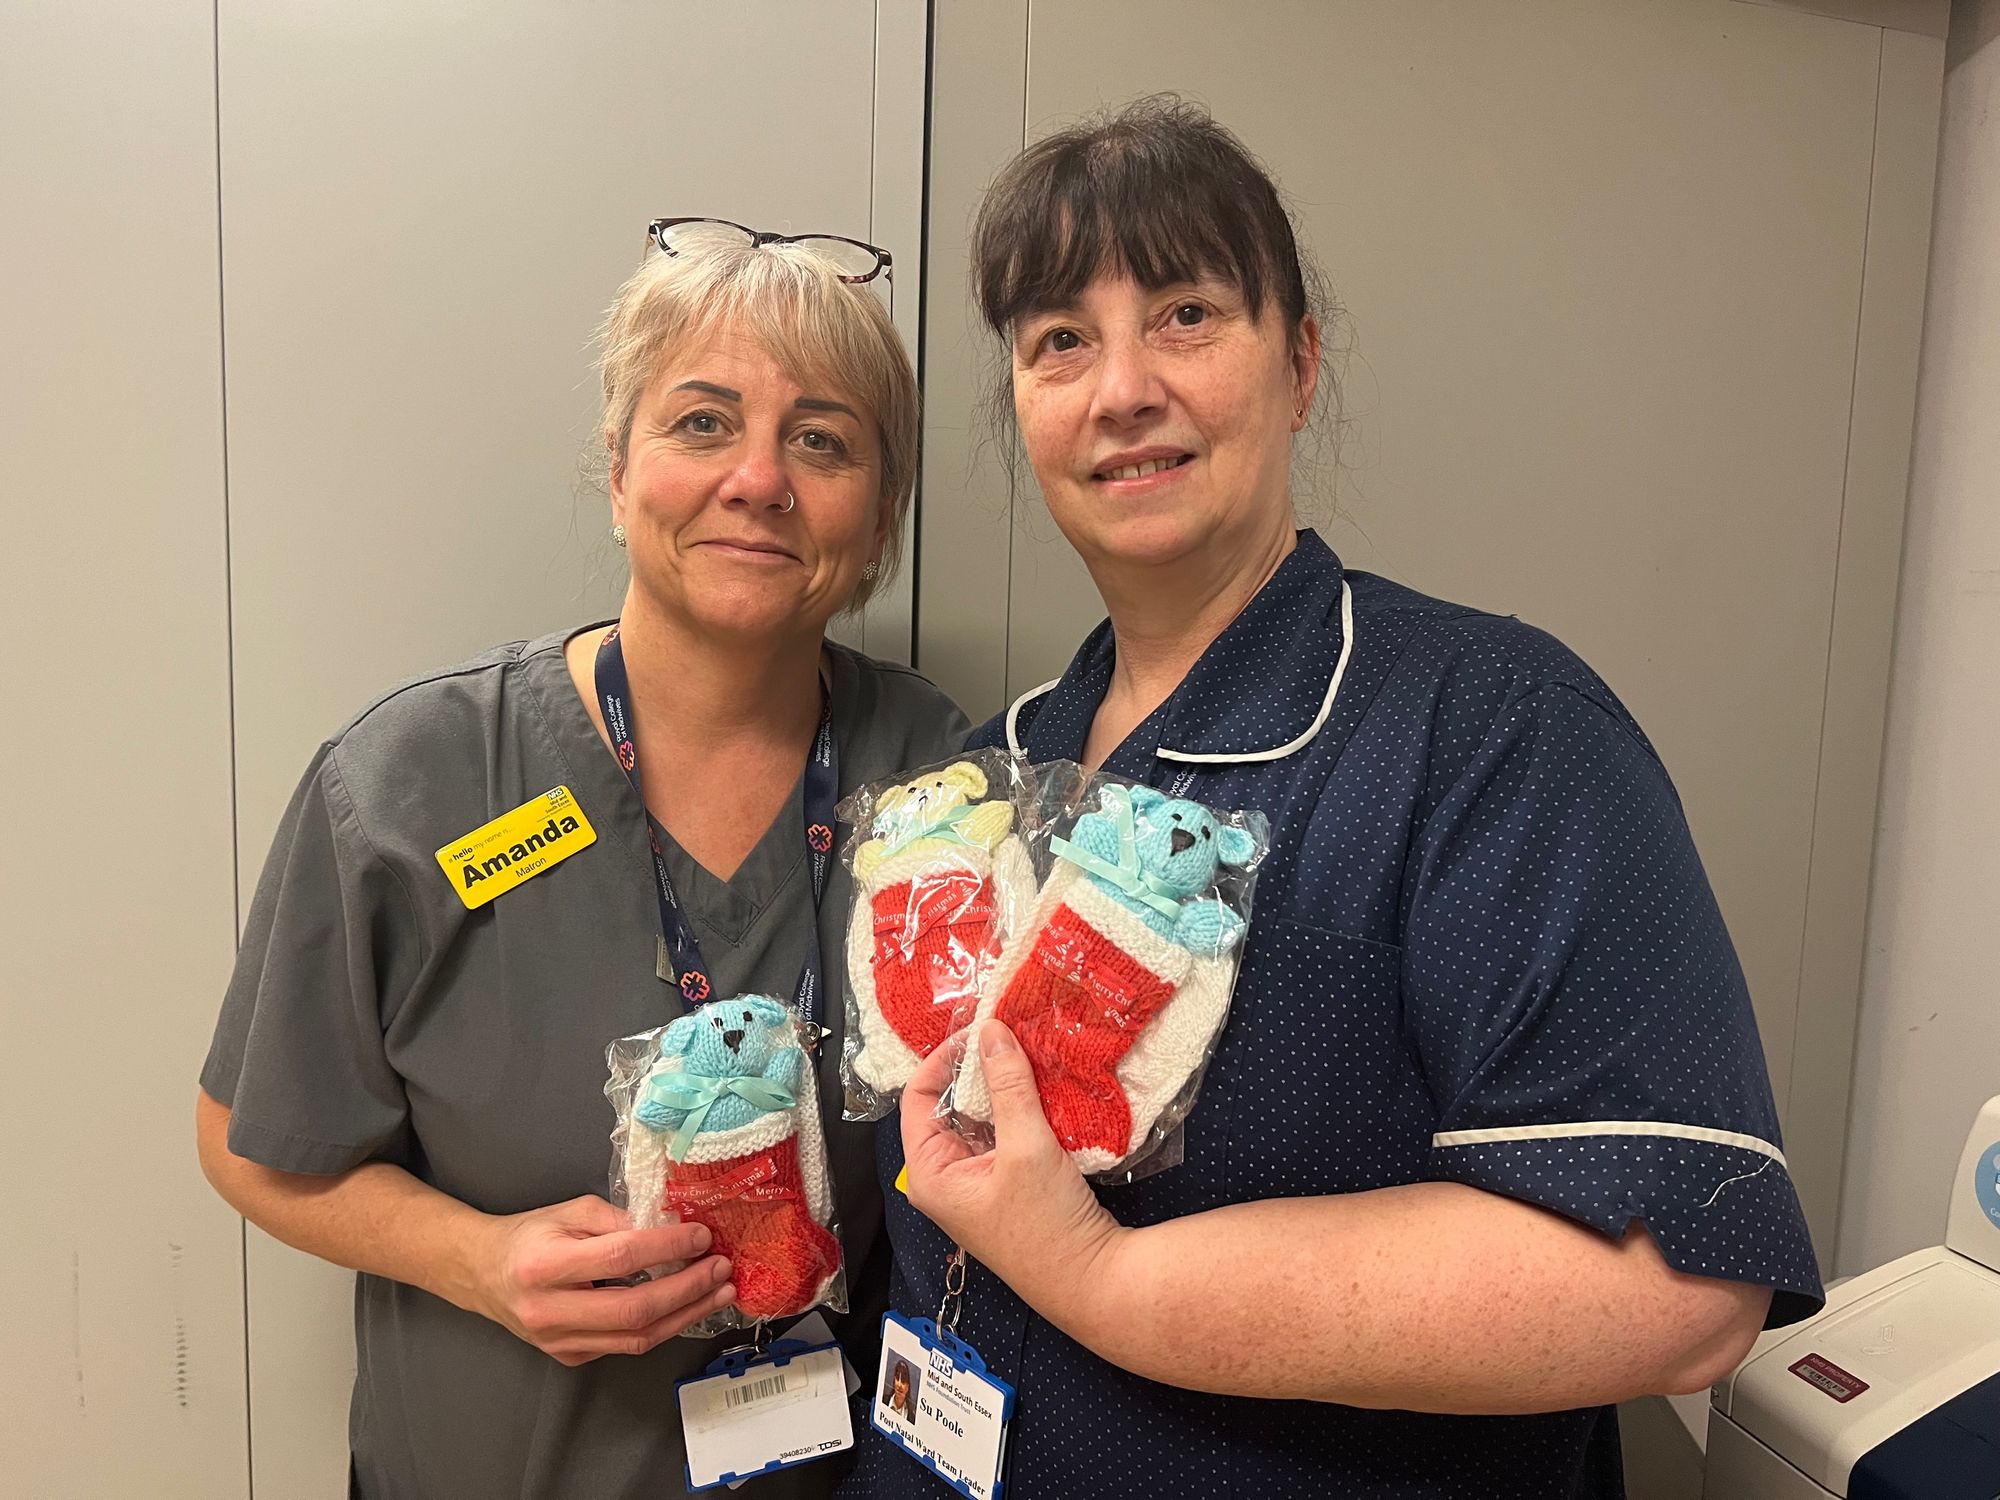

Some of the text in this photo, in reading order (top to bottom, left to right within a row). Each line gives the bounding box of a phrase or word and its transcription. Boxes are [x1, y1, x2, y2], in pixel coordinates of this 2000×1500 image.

[606, 694, 622, 743] Royal College
[615, 697, 625, 731] Midwives
[822, 741, 831, 768] College
[547, 788, 564, 801] NHS
[462, 815, 580, 890] Amanda
[473, 841, 484, 851] my
[484, 831, 502, 845] name
[515, 857, 547, 878] Matron
[800, 968, 810, 997] College
[805, 974, 815, 1021] of Midwives
[696, 1192, 722, 1207] Merry
[756, 1187, 784, 1197] Merry
[930, 1353, 953, 1377] NHS
[1825, 1364, 1862, 1389] PROPERTY
[927, 1369, 993, 1420] Mid and South Essex
[920, 1397, 964, 1438] Su Poole
[879, 1411, 986, 1496] Post Natal Ward Team Leader
